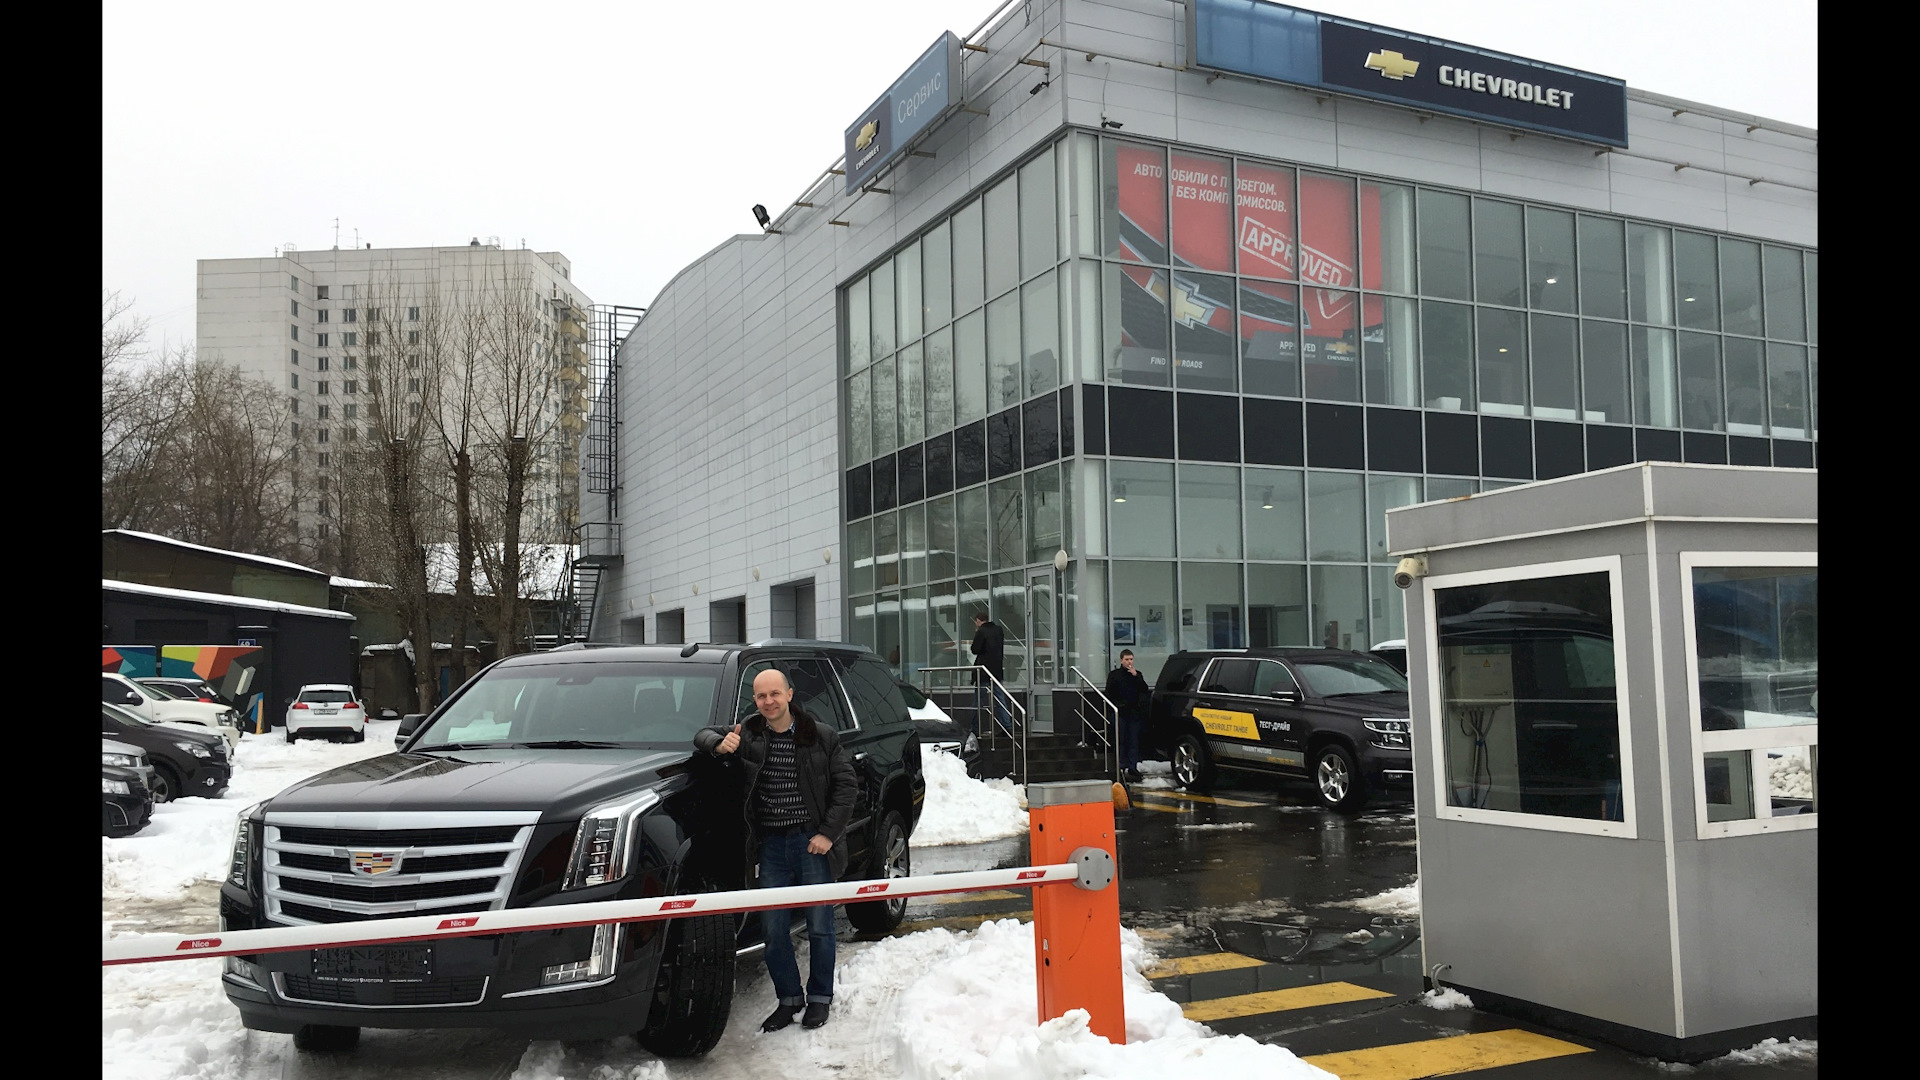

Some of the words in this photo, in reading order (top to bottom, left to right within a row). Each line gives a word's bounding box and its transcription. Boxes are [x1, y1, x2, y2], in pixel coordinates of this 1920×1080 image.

[1438, 64, 1574, 110] CHEVROLET
[897, 72, 941, 124] Сервис
[855, 144, 880, 170] CHEVROLET
[1134, 163, 1208, 185] АВТООБИЛИ
[1220, 176, 1277, 195] ПОБЕГОМ.
[1176, 185, 1197, 200] БЕЗ
[1199, 189, 1287, 212] КОМПОМИССОВ.
[1280, 341, 1316, 352] APPVED
[1150, 356, 1166, 366] FIND
[1181, 359, 1203, 369] ROADS
[1205, 722, 1232, 732] CHEVROLET
[1233, 724, 1248, 734] TAHOE
[1259, 720, 1291, 731] ТЕСТ-ДРАЙВ
[191, 940, 210, 948] Nice
